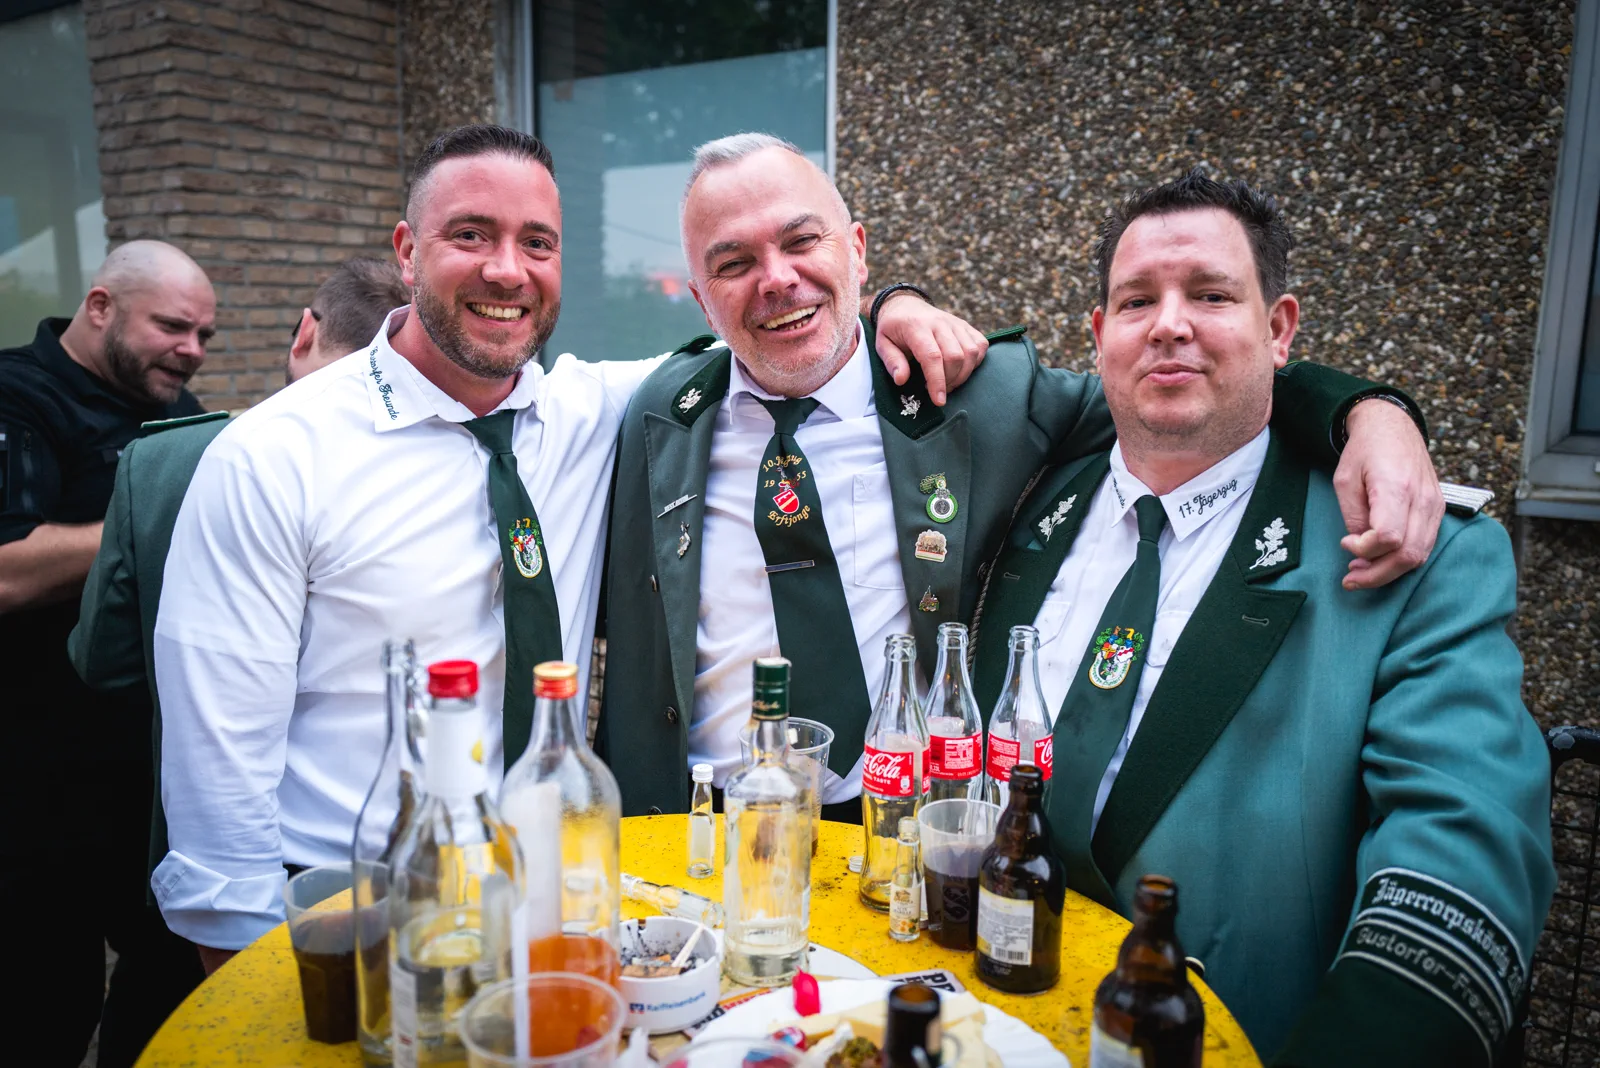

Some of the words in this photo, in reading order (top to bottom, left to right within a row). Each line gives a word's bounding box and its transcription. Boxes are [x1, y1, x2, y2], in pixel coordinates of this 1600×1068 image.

[379, 384, 398, 421] Freunde
[1178, 504, 1195, 519] 17.
[1193, 478, 1238, 515] Jägerzug
